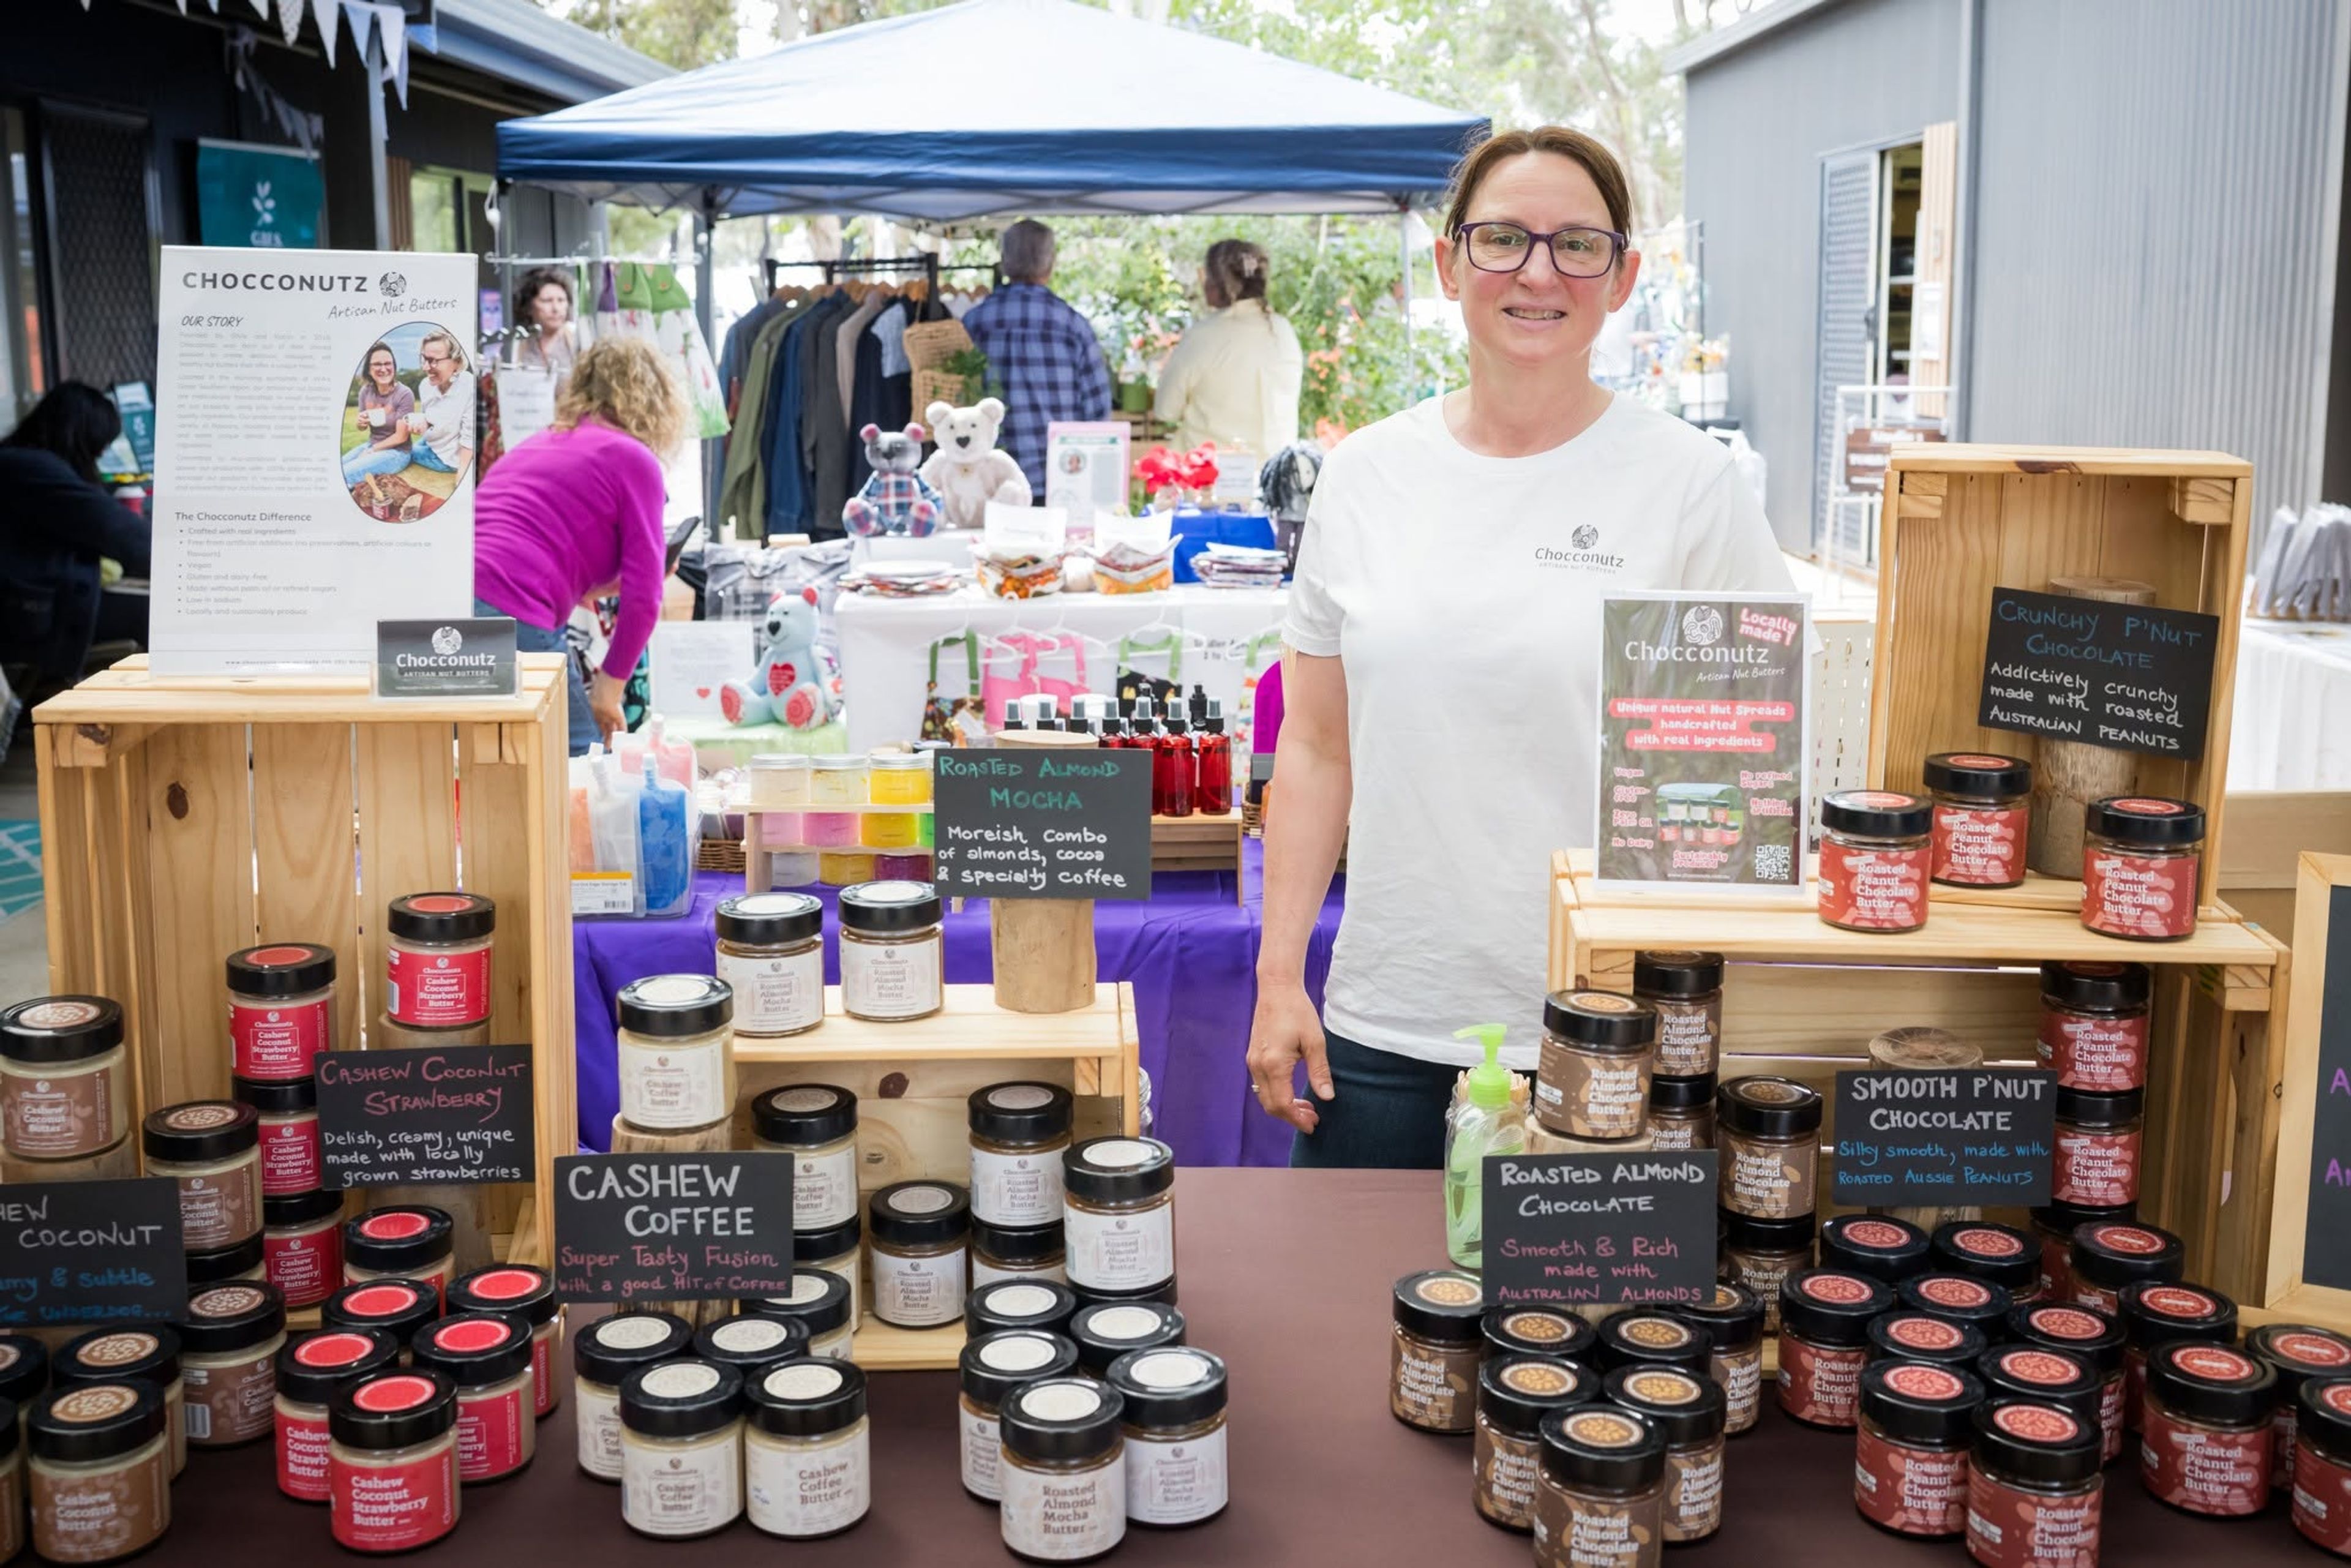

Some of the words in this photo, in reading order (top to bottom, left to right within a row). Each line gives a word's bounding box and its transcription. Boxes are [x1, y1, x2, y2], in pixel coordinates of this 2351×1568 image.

[182, 271, 369, 292] CHOCCONUTZ
[328, 304, 377, 320] Artisan
[380, 301, 405, 315] Nut
[408, 298, 457, 312] Butters
[181, 315, 203, 328] OUR
[207, 316, 244, 328] STORY
[175, 512, 194, 521] The
[197, 512, 257, 521] Chocconutz
[259, 513, 312, 522] Difference
[1534, 547, 1624, 568] Chocconutz
[1740, 607, 1798, 646] Locally
[1997, 599, 2099, 642] CRUNCHY
[2124, 616, 2202, 648] P'NUT
[1625, 640, 1769, 664] Chocconutz
[2026, 633, 2154, 669] CHOCOLATE
[396, 653, 497, 667] Chocconutz
[1990, 661, 2088, 698] Addictively
[2104, 681, 2178, 711] crunchy
[1616, 702, 1658, 715] Unique
[1661, 703, 1706, 715] natural
[1710, 704, 1731, 715] Nut
[1735, 705, 1787, 717] Spreads
[1990, 685, 2034, 703] made
[2048, 692, 2090, 711] with
[2105, 702, 2184, 729] roasted
[1660, 719, 1737, 731] handcrafted
[1634, 730, 1660, 744] with
[1663, 732, 1689, 745] real
[1693, 733, 1763, 748] ingredients
[2099, 724, 2180, 751] PEANUTS
[939, 756, 1022, 779] ROASTED
[1038, 757, 1121, 779] ALMOND
[989, 787, 1083, 811] MOCHA
[947, 824, 1029, 844] Moreish
[938, 847, 956, 859] of
[967, 847, 1047, 867] almonds,
[1056, 849, 1105, 862] cocoa
[1858, 863, 1907, 876] Roasted
[2104, 868, 2155, 882] Roasted
[937, 866, 950, 882] &
[961, 866, 1047, 891] specialty
[1857, 874, 1900, 886] Peanut
[2104, 878, 2148, 893] Peanut
[1856, 885, 1915, 897] Chocolate
[2104, 890, 2166, 906] Chocolate
[1856, 896, 1896, 909] Butter
[2103, 901, 2143, 916] Butter
[1663, 1013, 1706, 1024] Roasted
[1662, 1023, 1705, 1034] Almond
[2076, 1030, 2123, 1041] Roasted
[1662, 1034, 1712, 1045] Chocolate
[2075, 1040, 2118, 1052] Peanut
[1662, 1045, 1696, 1055] Butter
[2075, 1051, 2131, 1063] Chocolate
[320, 1059, 412, 1086] CASHEW
[421, 1056, 527, 1082] COCONUT
[2075, 1062, 2113, 1073] Butter
[1851, 1076, 1958, 1101] SMOOTH
[1973, 1074, 2048, 1101] P'NUT
[363, 1086, 503, 1123] STRAWBERRY
[1869, 1108, 2012, 1131] CHOCOLATE
[324, 1131, 383, 1149] Delish,
[456, 1129, 516, 1149] unique
[326, 1152, 372, 1165] made
[379, 1147, 416, 1162] with
[1735, 1152, 1781, 1167] Roasted
[1839, 1140, 1880, 1167] Silky
[1885, 1142, 1957, 1166] smooth,
[1964, 1141, 2010, 1157] made
[2015, 1141, 2049, 1157] with
[342, 1169, 399, 1188] grown
[410, 1165, 522, 1181] strawberries
[1500, 1163, 1602, 1187] ROASTED
[1612, 1161, 1706, 1184] ALMOND
[1735, 1163, 1781, 1177] Almond
[1839, 1171, 1893, 1185] ROASTED
[1905, 1168, 1955, 1184] AUSSIE
[1963, 1165, 2033, 1186] PEANUTS
[568, 1163, 741, 1201] CASHEW
[1734, 1173, 1791, 1188] Chocolate
[1734, 1183, 1769, 1198] Butter
[1518, 1193, 1654, 1217] CHOCOLATE
[18, 1221, 163, 1248] COCONUT
[1500, 1238, 1588, 1258] Smooth
[1595, 1236, 1616, 1258] &
[1632, 1236, 1679, 1259] Rich
[561, 1245, 620, 1278] Super
[631, 1245, 689, 1275] Tasty
[705, 1245, 779, 1269] Fusion
[1544, 1263, 1600, 1278] made
[1611, 1262, 1659, 1279] with
[558, 1278, 593, 1294] with
[602, 1280, 613, 1292] a
[621, 1277, 667, 1297] good
[1621, 1286, 1703, 1302] ALMONDS
[2186, 1441, 2243, 1458] Roasted
[2186, 1453, 2235, 1469] Peanut
[798, 1462, 849, 1480] Cashew
[2185, 1466, 2253, 1482] Chocolate
[351, 1475, 405, 1489] Cashew
[798, 1477, 843, 1493] Coffee
[1042, 1482, 1096, 1497] Roasted
[2184, 1477, 2230, 1494] Butter
[351, 1488, 410, 1501] Coconut
[800, 1490, 842, 1506] Butter
[1043, 1495, 1097, 1510] Almond
[352, 1496, 429, 1514] Strawberry
[353, 1513, 396, 1526] Butter
[1043, 1509, 1090, 1523] Mocha
[1043, 1521, 1087, 1535] Butter
